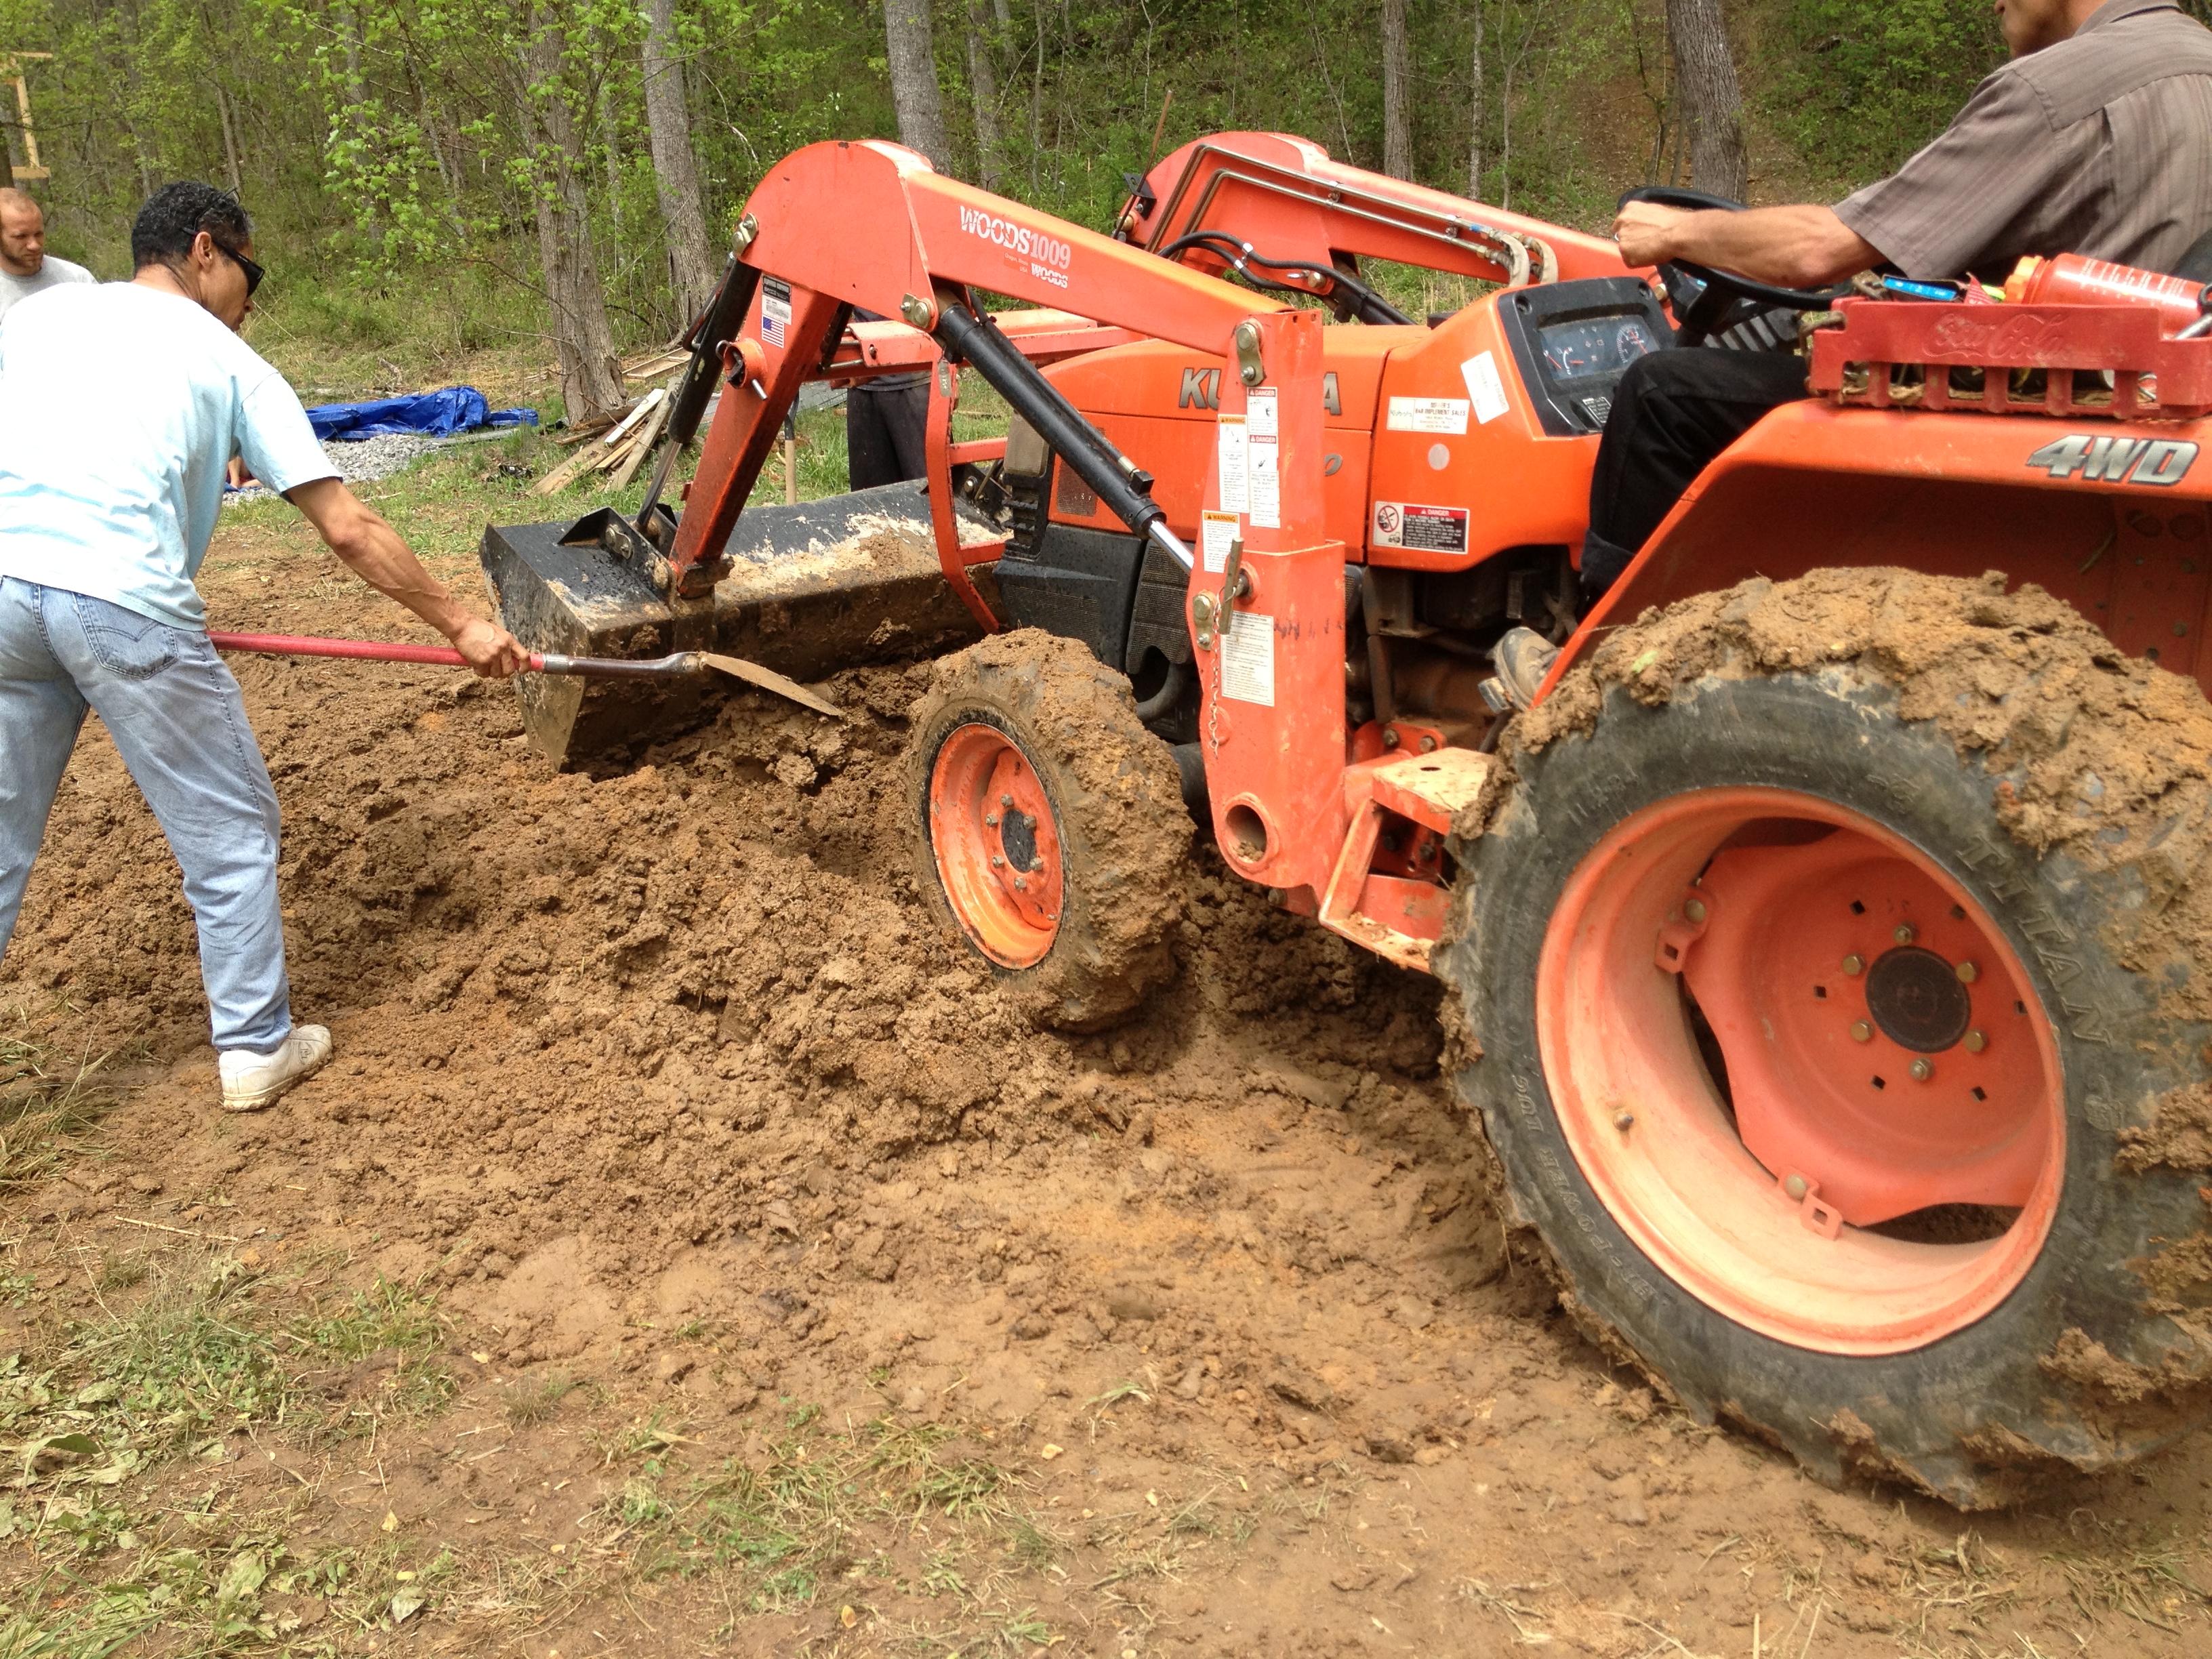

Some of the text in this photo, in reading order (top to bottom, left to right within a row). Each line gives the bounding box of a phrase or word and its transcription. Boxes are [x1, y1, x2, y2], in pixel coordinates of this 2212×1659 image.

[960, 205, 1071, 270] WOODS 1009
[1031, 262, 1068, 289] WOODS
[2026, 434, 2199, 487] 4WD
[1212, 514, 1235, 523] WARNING
[1955, 834, 2113, 1048] TITAN
[1512, 1075, 1544, 1132] LUG
